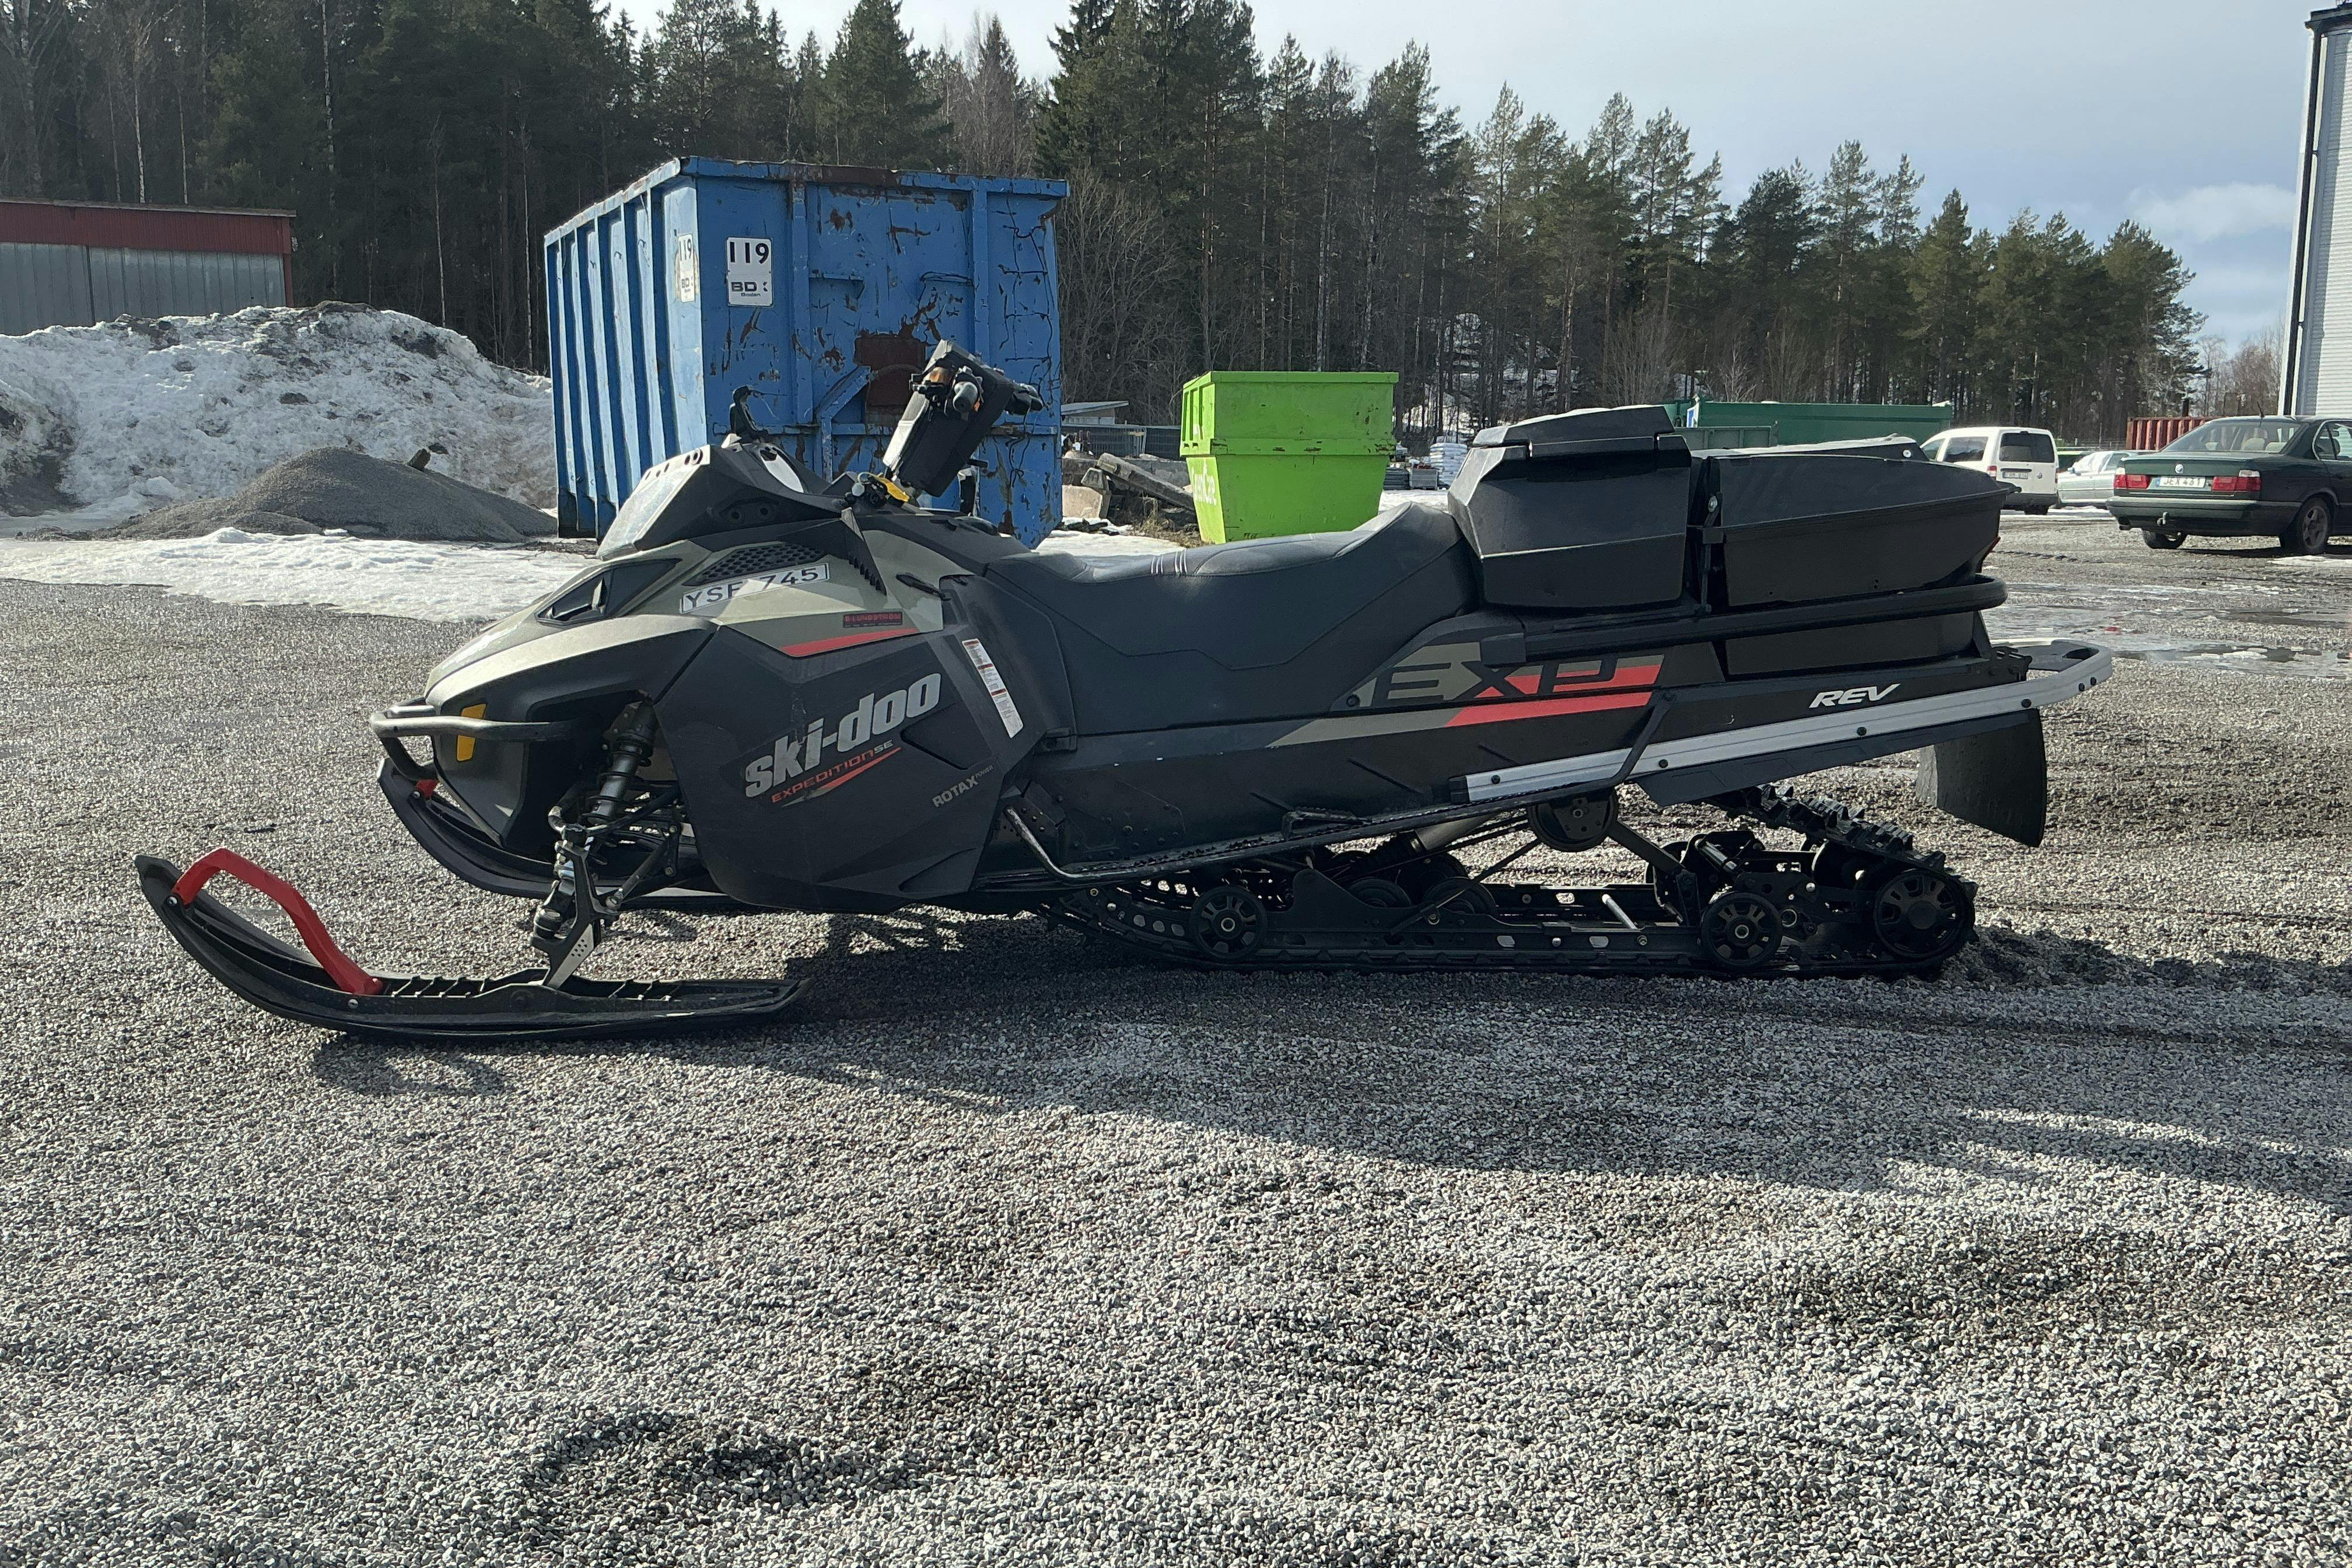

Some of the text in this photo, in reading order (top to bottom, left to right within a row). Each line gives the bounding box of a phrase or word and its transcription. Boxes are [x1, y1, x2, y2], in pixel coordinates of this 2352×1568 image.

[679, 238, 692, 261] 119
[730, 241, 769, 264] 119
[760, 567, 819, 590] 745
[1372, 656, 1617, 706] EXP
[1808, 683, 1901, 709] REV
[746, 673, 942, 798] ski-doo
[932, 775, 979, 808] ROTAX
